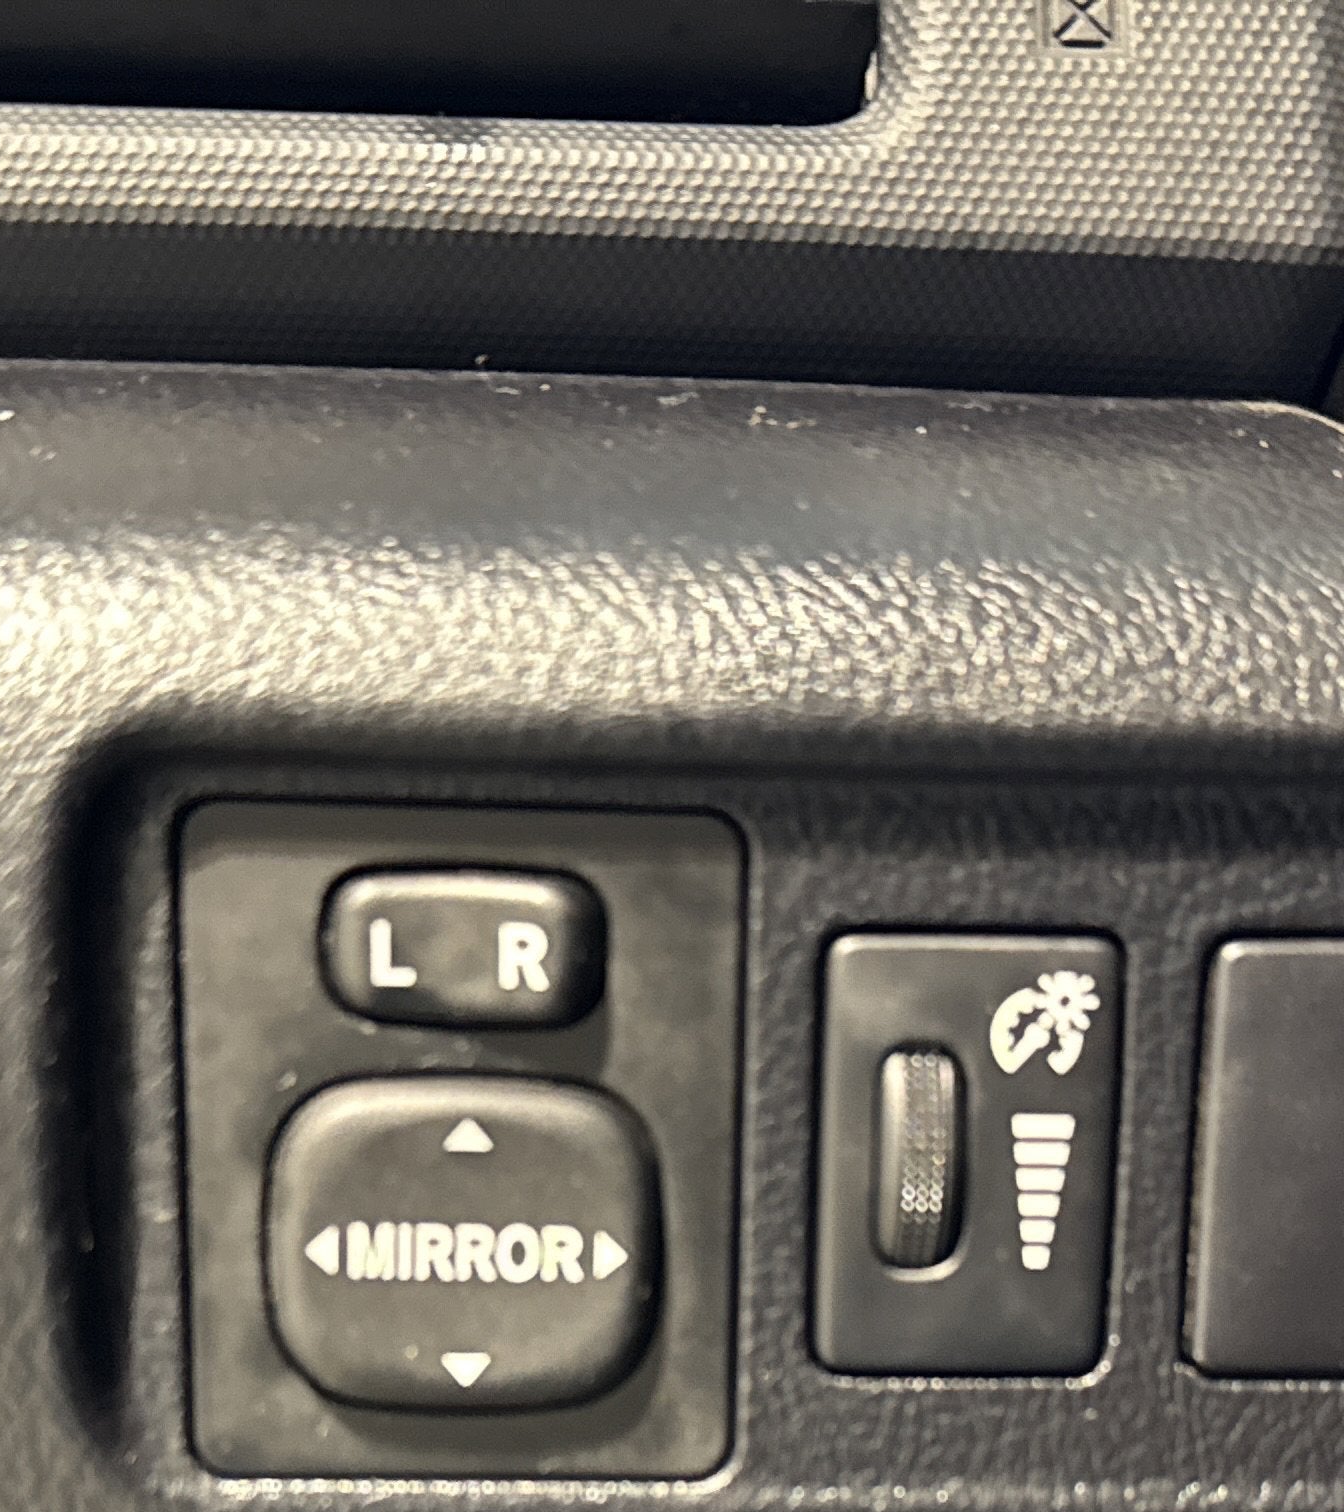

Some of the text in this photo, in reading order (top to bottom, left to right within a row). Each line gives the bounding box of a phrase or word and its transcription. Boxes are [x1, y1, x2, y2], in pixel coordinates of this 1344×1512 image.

[369, 918, 550, 992] L R
[346, 1220, 585, 1284] MIRROR
